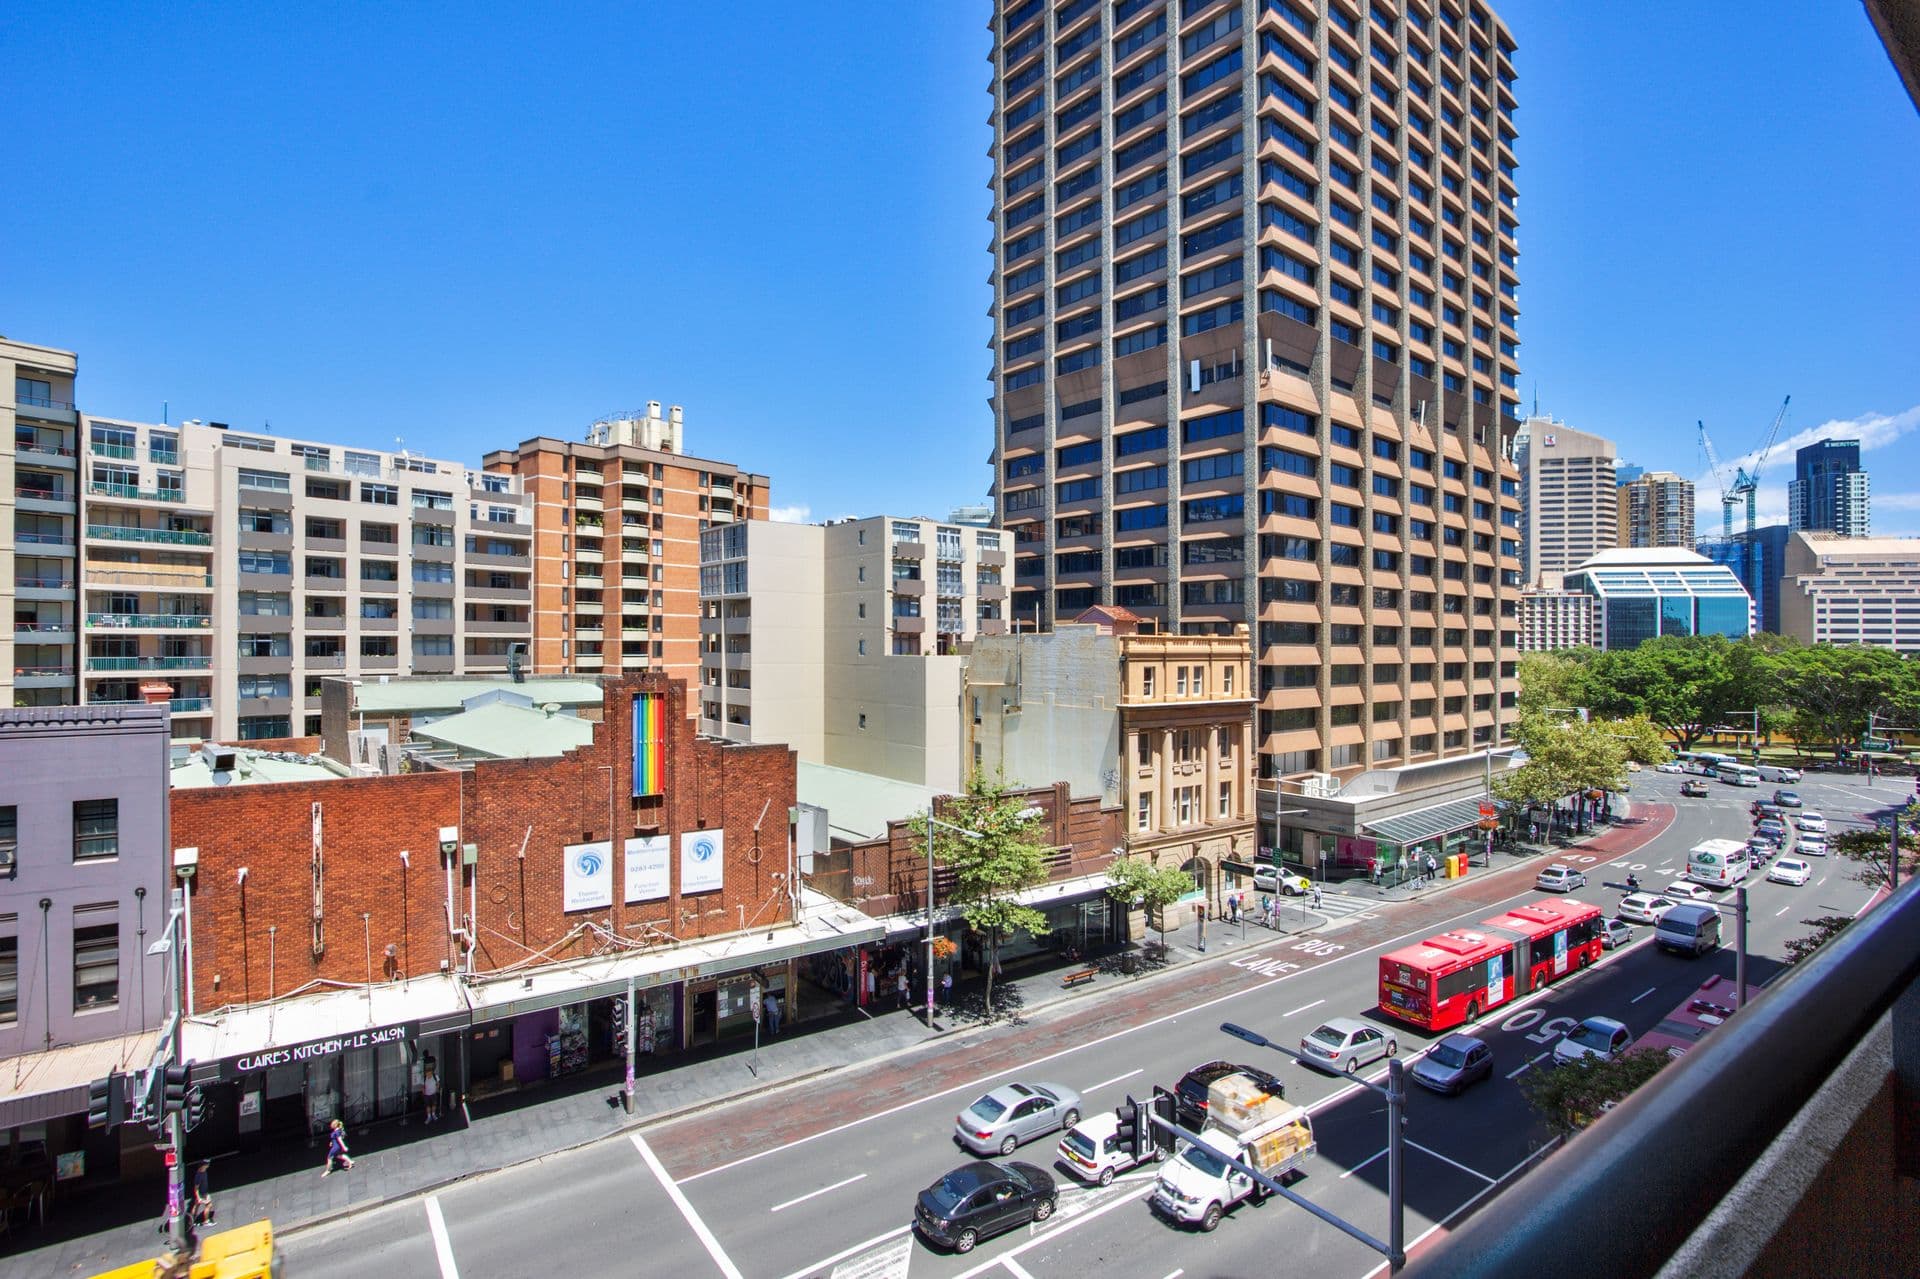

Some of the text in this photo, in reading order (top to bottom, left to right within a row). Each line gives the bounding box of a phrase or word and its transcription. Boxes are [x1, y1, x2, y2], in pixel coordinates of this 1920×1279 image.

[1559, 854, 1597, 863] 40
[1609, 861, 1648, 871] 40
[1290, 939, 1345, 957] BUS
[1229, 953, 1301, 977] LANE
[237, 1049, 291, 1071] CLAIRE'S
[293, 1039, 342, 1060] KITCHEN
[371, 1026, 406, 1044] SALON
